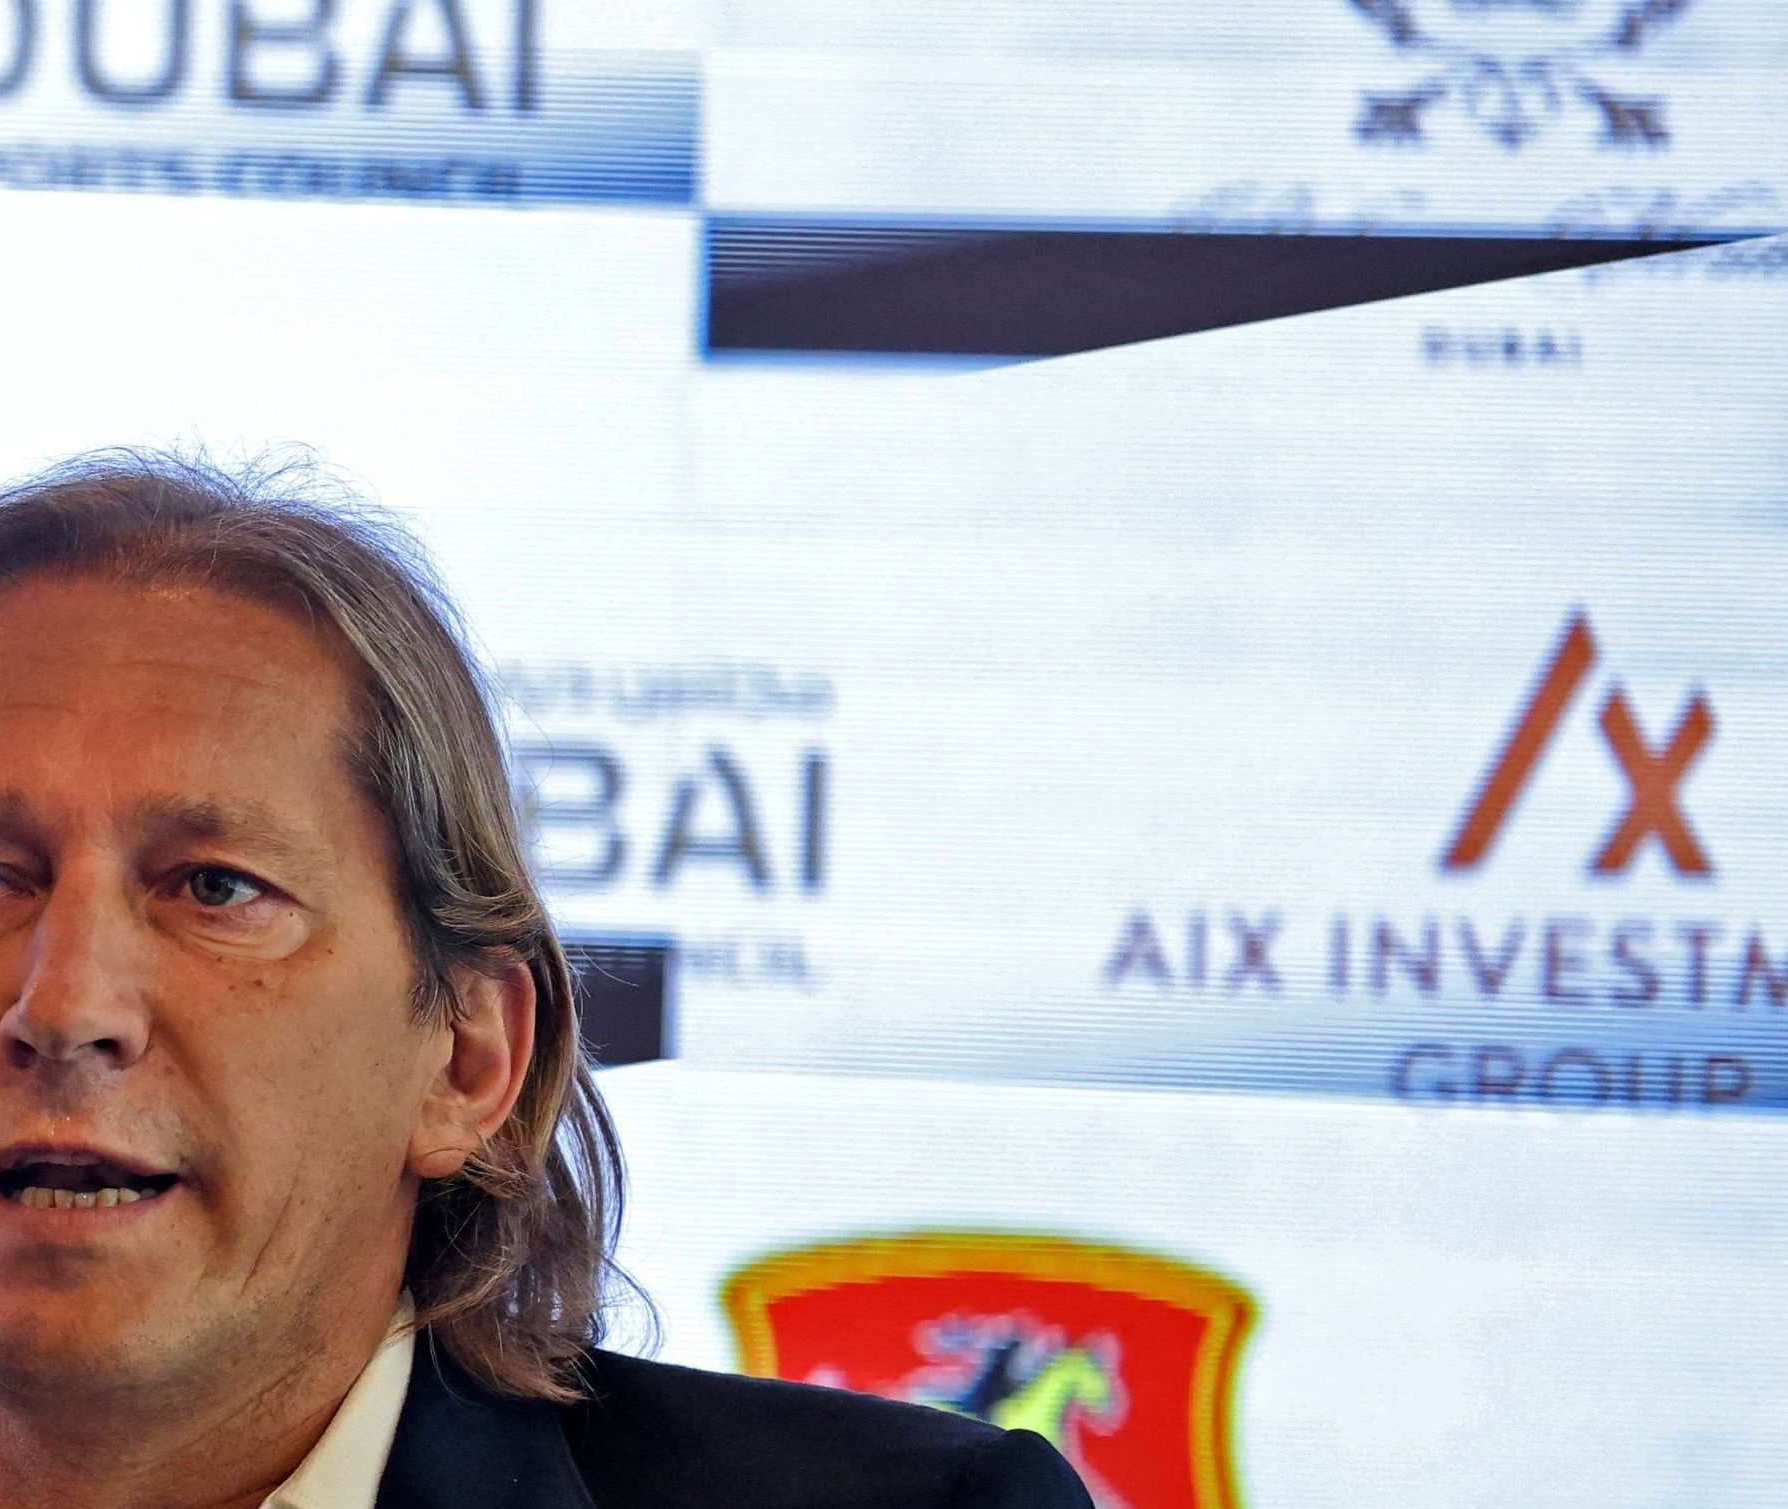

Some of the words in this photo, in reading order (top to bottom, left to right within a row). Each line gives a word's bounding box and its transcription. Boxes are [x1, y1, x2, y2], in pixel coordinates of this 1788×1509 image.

[511, 735, 829, 896] BAI
[1107, 908, 1283, 992] AIX
[1329, 914, 1788, 1008] INVESTM
[1391, 1044, 1755, 1106] GROUP
